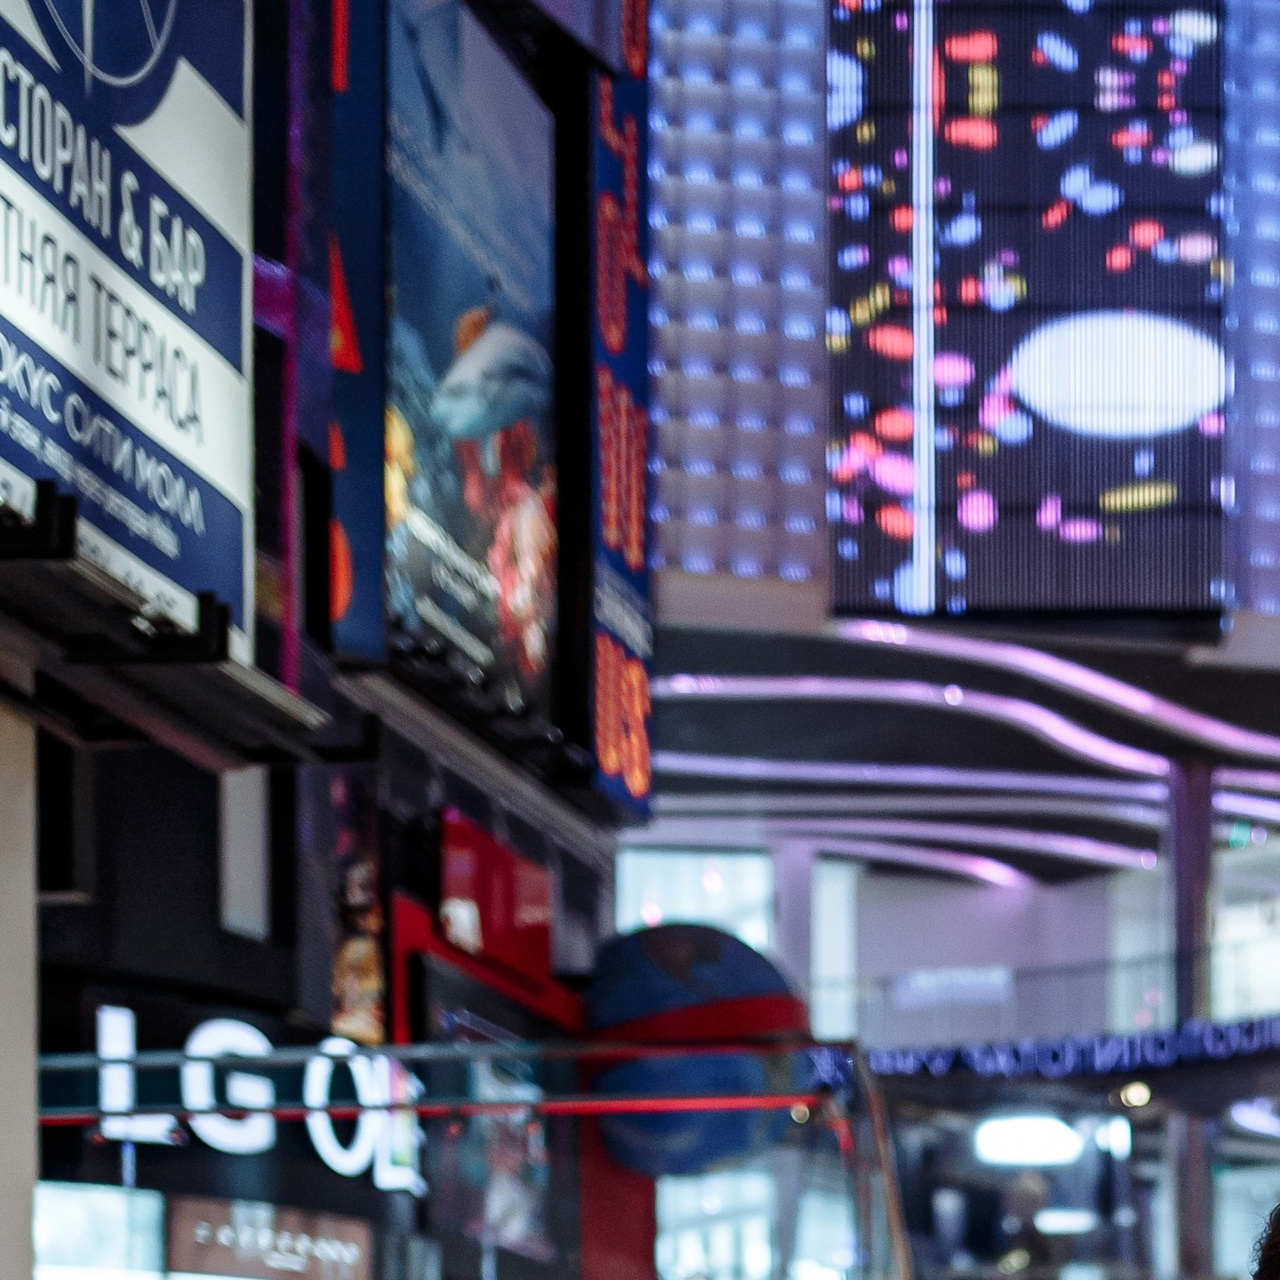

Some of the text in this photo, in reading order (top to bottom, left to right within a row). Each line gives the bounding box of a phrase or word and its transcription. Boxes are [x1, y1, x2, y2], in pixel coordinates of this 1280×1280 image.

[0, 46, 207, 316] СТОРАН & БАР
[89, 270, 204, 446] ТЕРРАСА
[96, 1004, 276, 1155] LG
